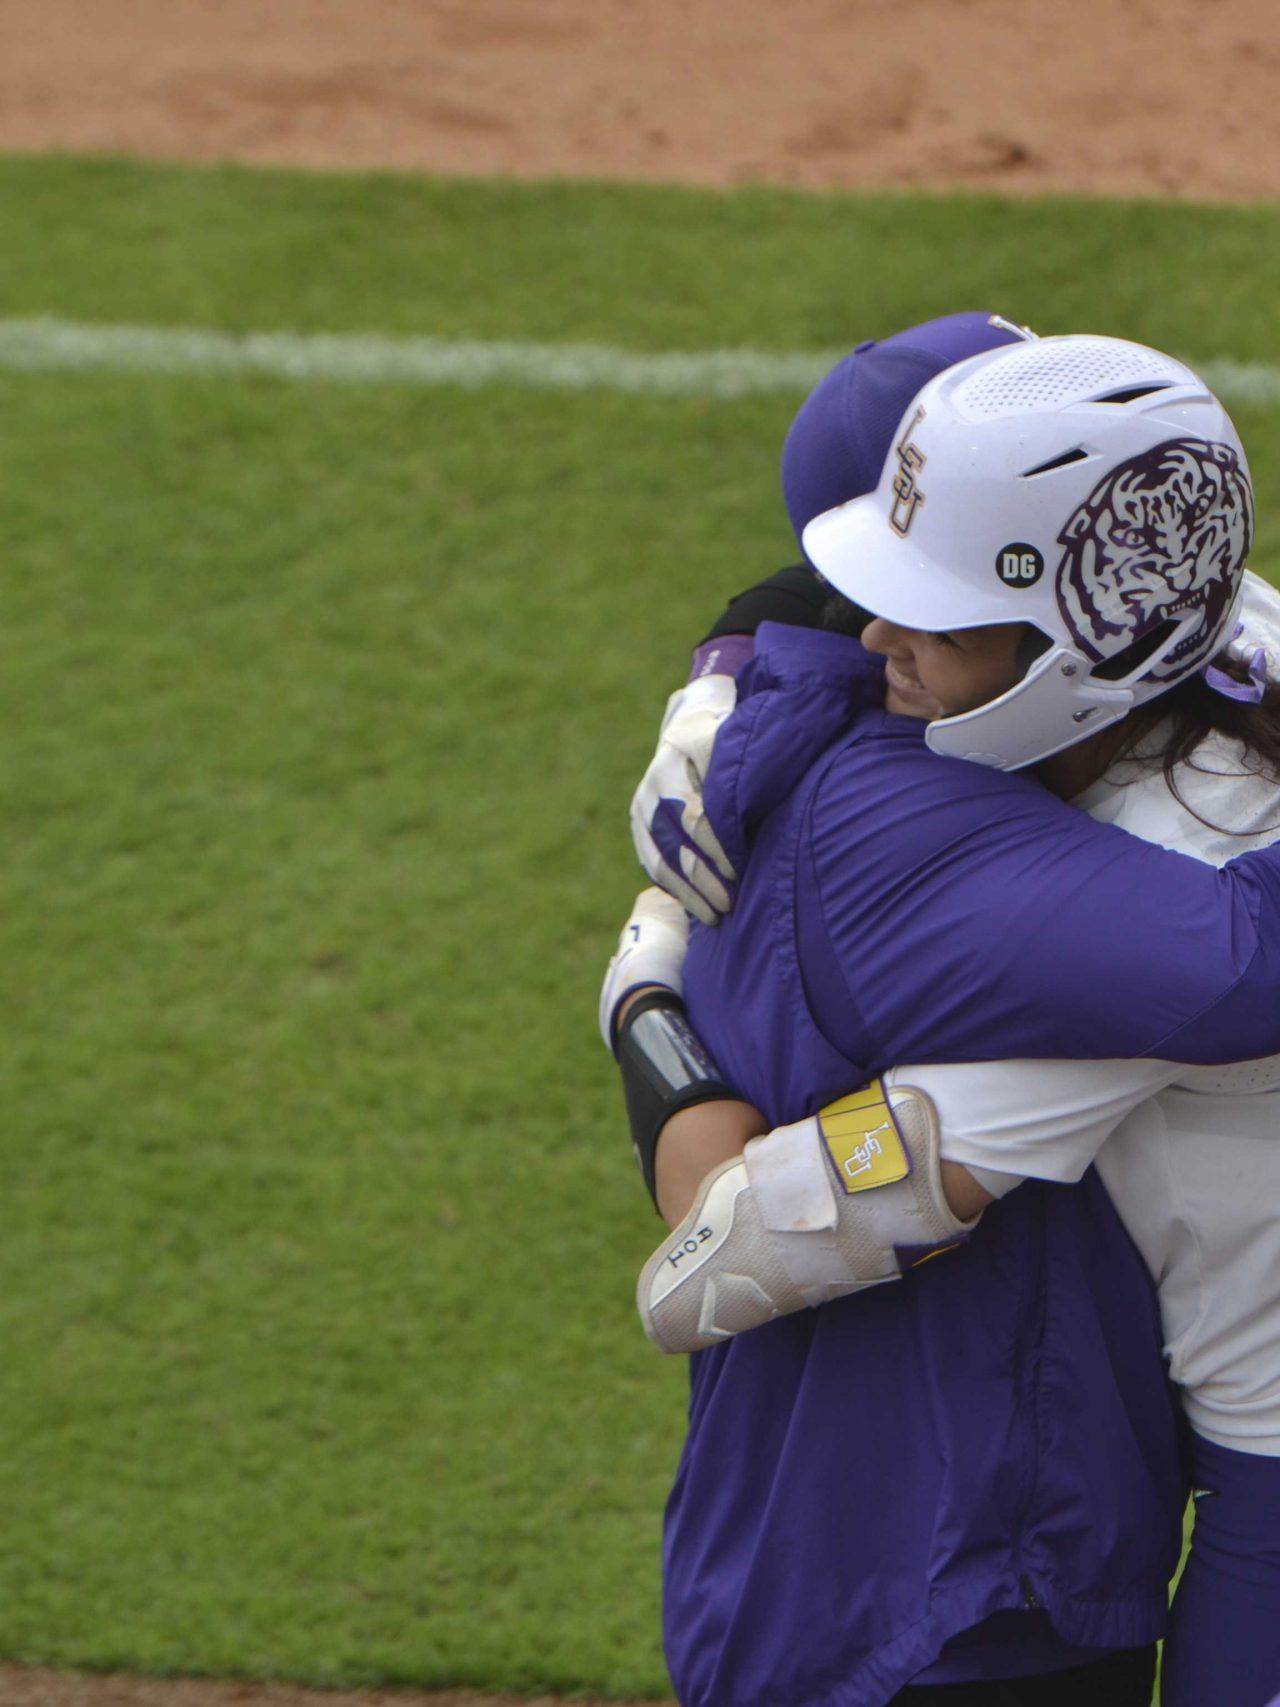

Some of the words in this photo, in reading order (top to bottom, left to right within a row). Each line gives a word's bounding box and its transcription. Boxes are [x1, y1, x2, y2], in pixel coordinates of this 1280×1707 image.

[889, 405, 927, 538] LSU
[1003, 553, 1036, 578] DG
[844, 1121, 889, 1177] LSU
